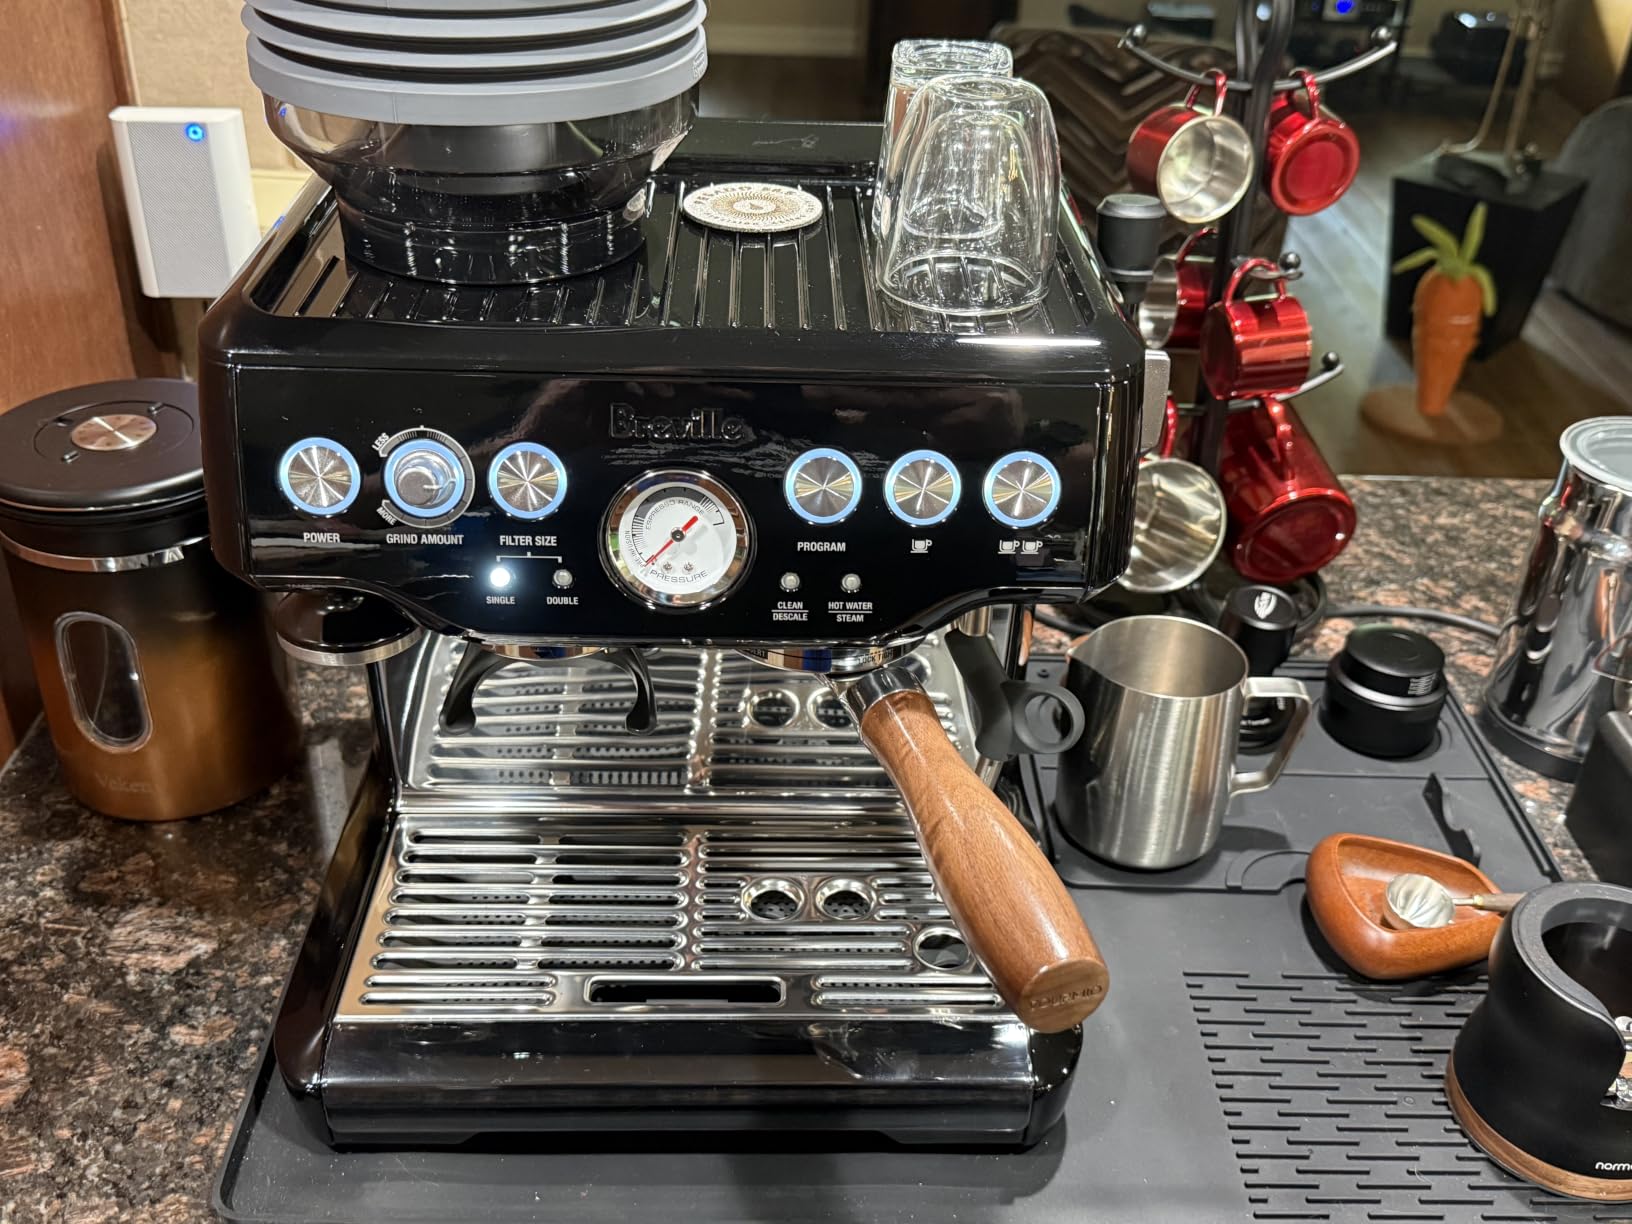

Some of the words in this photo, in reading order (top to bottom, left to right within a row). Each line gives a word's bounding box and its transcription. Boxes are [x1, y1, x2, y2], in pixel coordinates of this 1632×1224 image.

[609, 402, 744, 440] Breville
[371, 432, 390, 451] LESS
[376, 506, 397, 525] MORE
[645, 499, 676, 530] ESPRESSO
[678, 499, 704, 515] RANGE
[303, 532, 341, 544] POWER
[386, 533, 418, 545] GRIND
[420, 533, 464, 546] AMOUNT
[499, 535, 533, 547] FILTER
[535, 535, 558, 547] SIZE
[797, 541, 846, 552] PROGRAM
[649, 569, 708, 583] PRESSURE
[485, 595, 516, 605] SINGLE
[546, 596, 579, 605] DOUBLE
[777, 601, 803, 610] CLEAN
[828, 601, 844, 610] HOT
[845, 601, 873, 610] WATER
[772, 612, 808, 621] DESCALE
[836, 614, 864, 622] STEAM
[1595, 1161, 1632, 1172] norm
